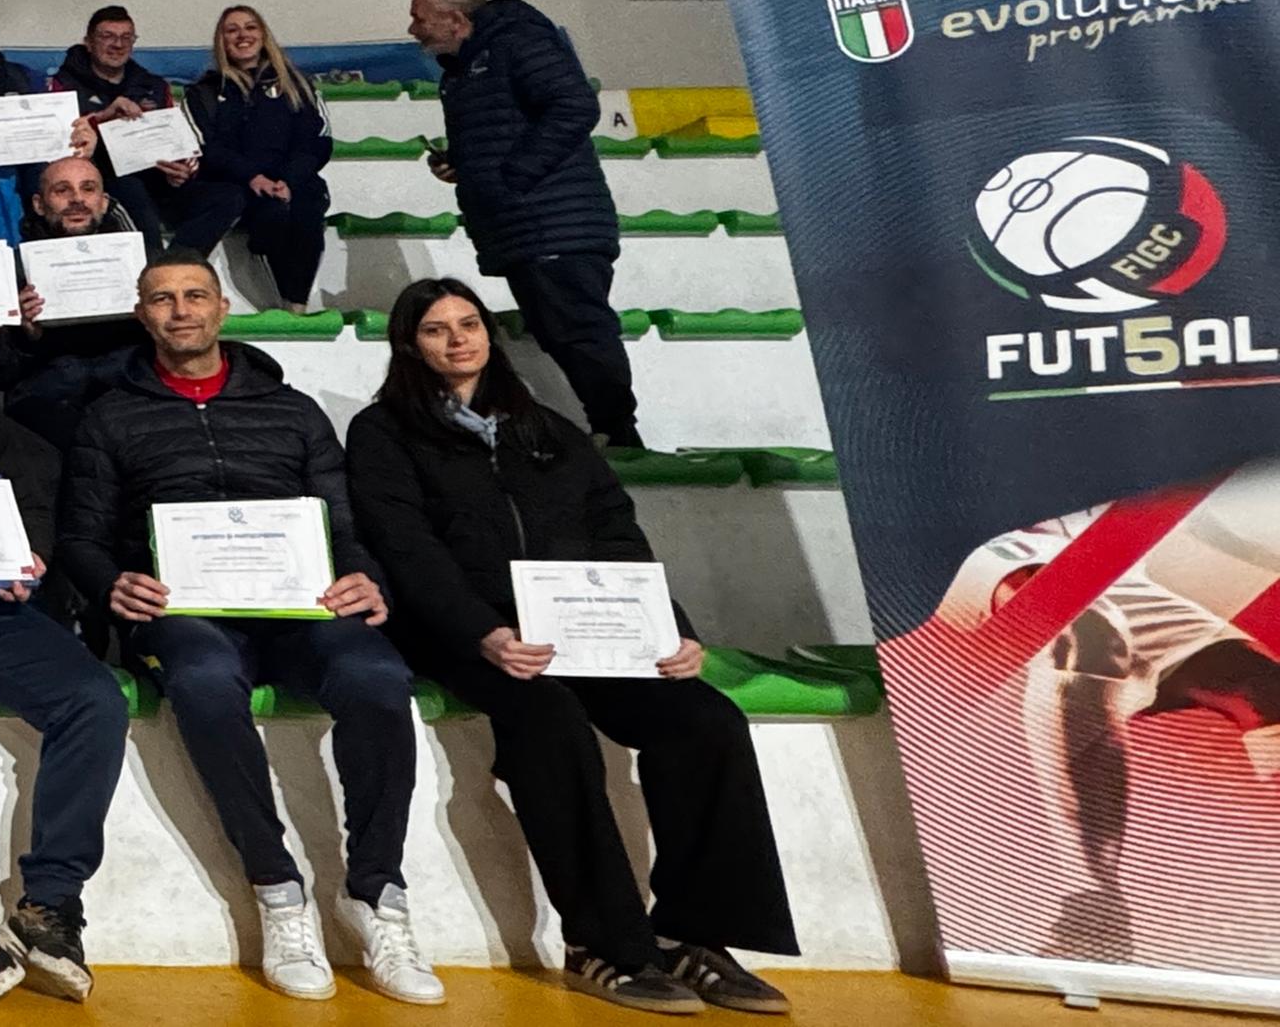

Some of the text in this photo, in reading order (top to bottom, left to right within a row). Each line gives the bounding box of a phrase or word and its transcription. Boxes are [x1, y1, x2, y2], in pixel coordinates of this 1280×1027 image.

[613, 112, 628, 128] A
[1110, 223, 1183, 280] FIGC
[986, 315, 1278, 380] FUT5AL
